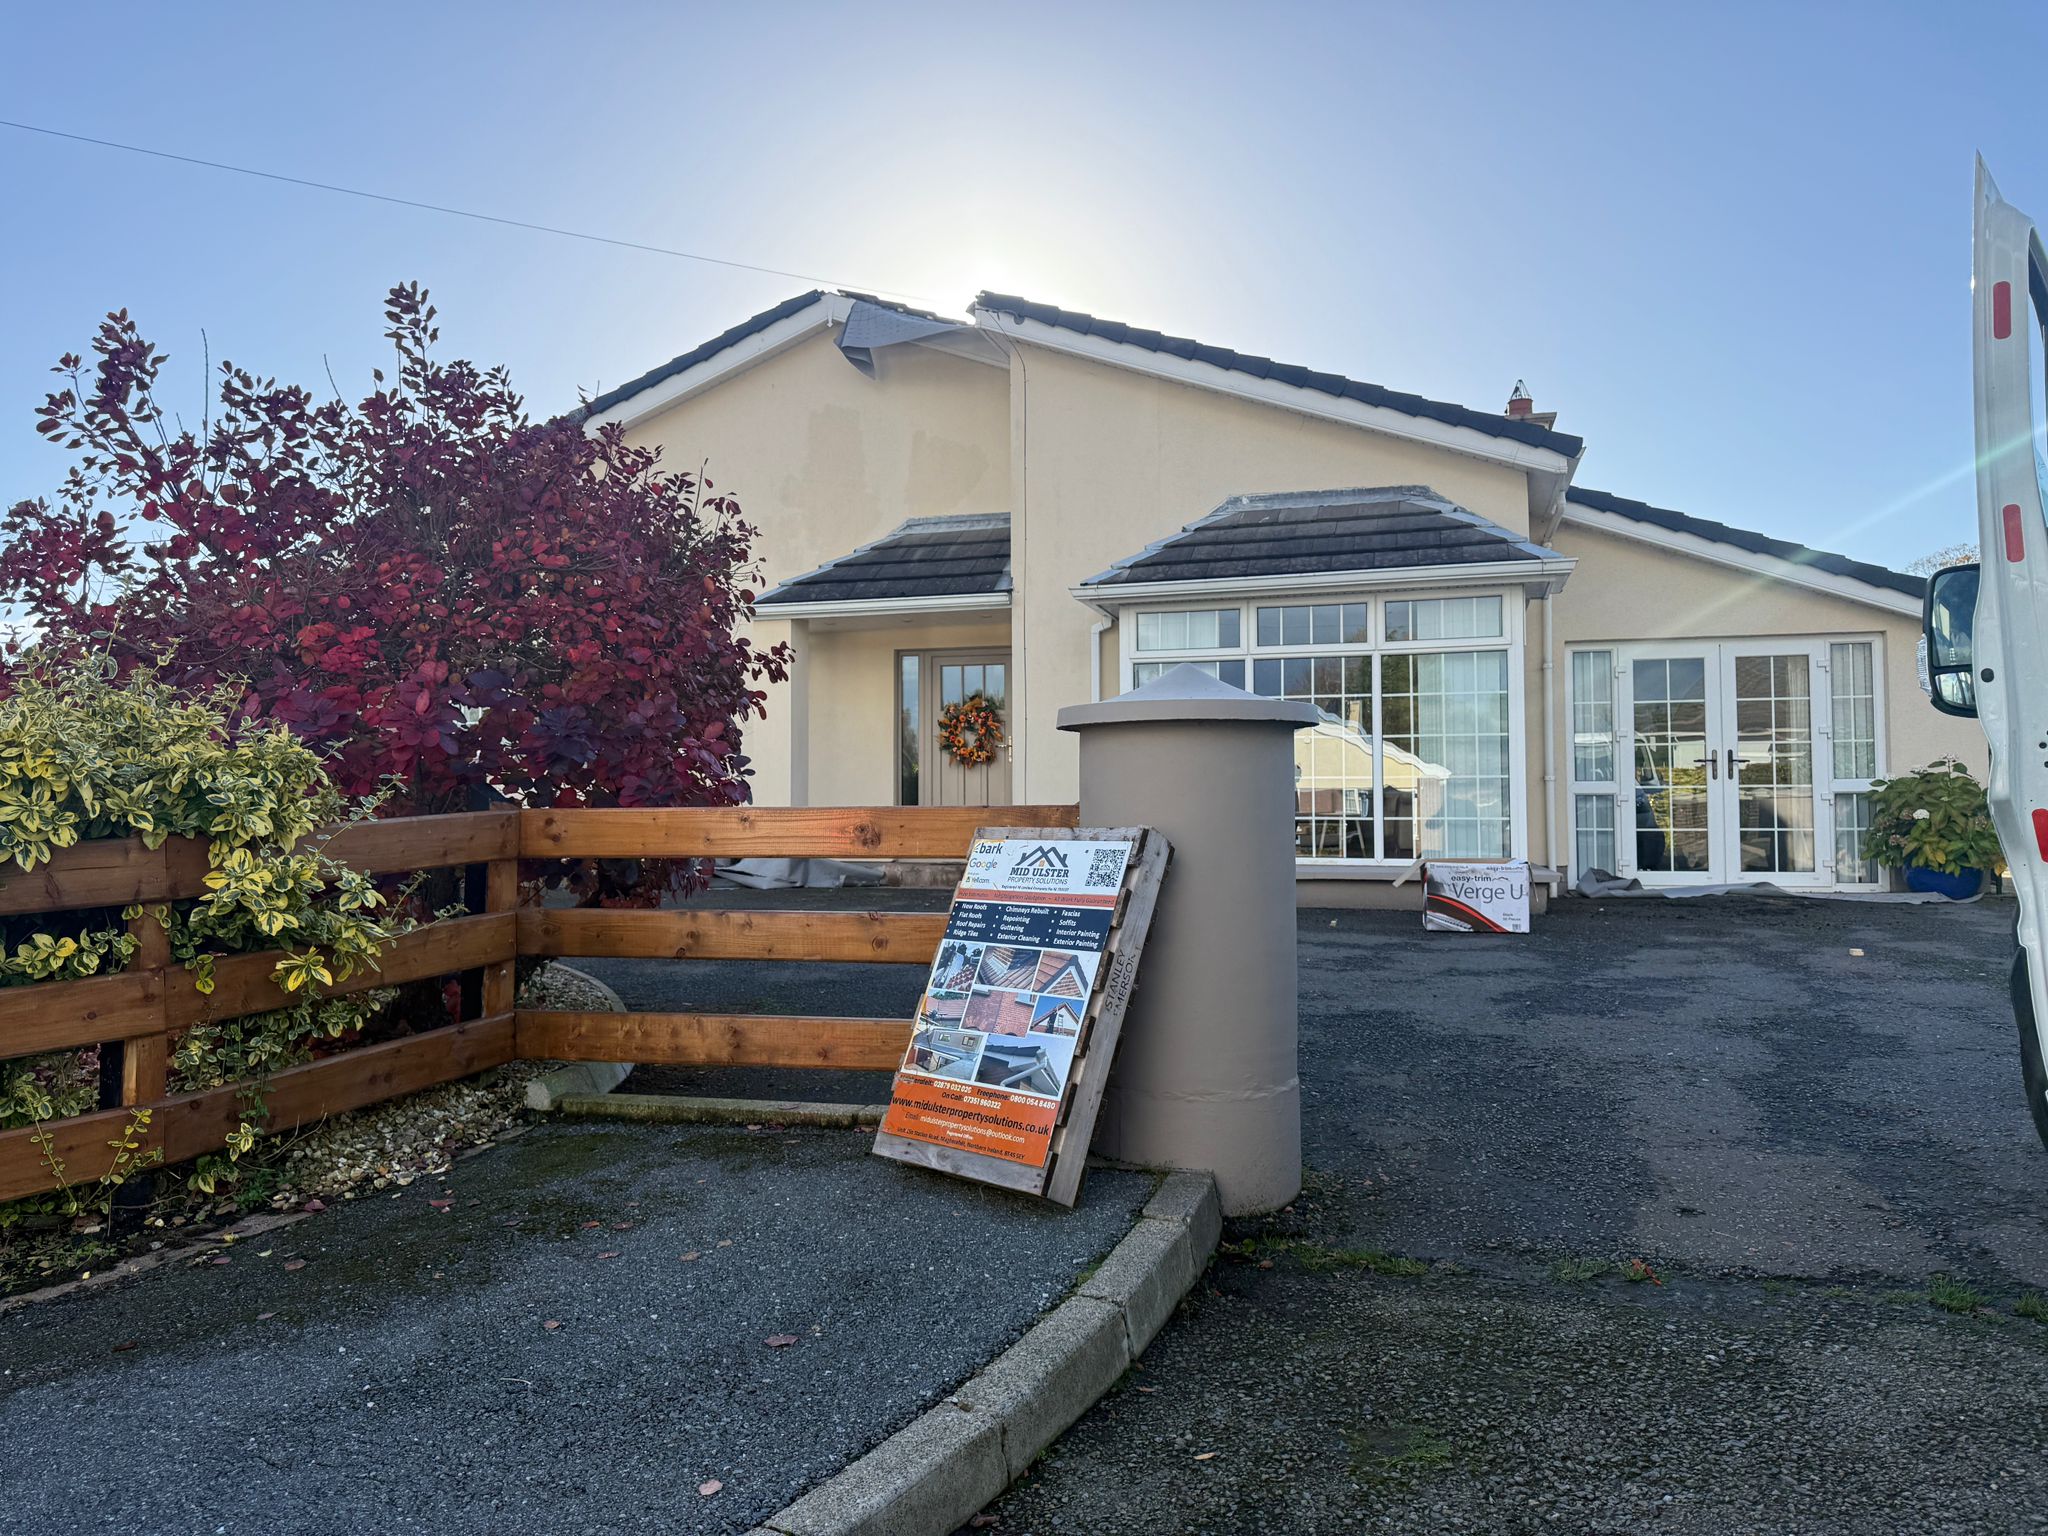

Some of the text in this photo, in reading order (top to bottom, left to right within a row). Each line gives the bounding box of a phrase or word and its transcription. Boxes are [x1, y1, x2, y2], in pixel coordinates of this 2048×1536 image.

[979, 843, 1004, 854] bark
[969, 858, 998, 870] Google
[1009, 867, 1069, 878] MID ULSTER
[1450, 875, 1492, 883] easy-trim
[1451, 882, 1523, 904] Verge U
[1005, 906, 1050, 915] Chimneys Rebuilt
[1061, 909, 1081, 917] Fascias
[1002, 915, 1030, 924] Repointing
[1058, 919, 1077, 927] Soffits
[968, 921, 986, 929] Repairs
[1000, 924, 1024, 933] Guttering
[952, 929, 966, 937] Ridge
[997, 933, 1040, 943] Exterior Cleaning
[1055, 928, 1101, 939] Interior Painting
[1053, 938, 1099, 949] Exterior Painting
[1104, 949, 1125, 1011] STANLEY
[963, 1095, 980, 1105] 07351
[976, 1088, 1056, 1109] Freephone: 0800 054 8480
[892, 1096, 1050, 1136] www.midulsterpropertysolutions.co.uk
[920, 1115, 1025, 1144] midulsterpropertysolutions@outlook.com
[966, 1142, 987, 1152] Northern
